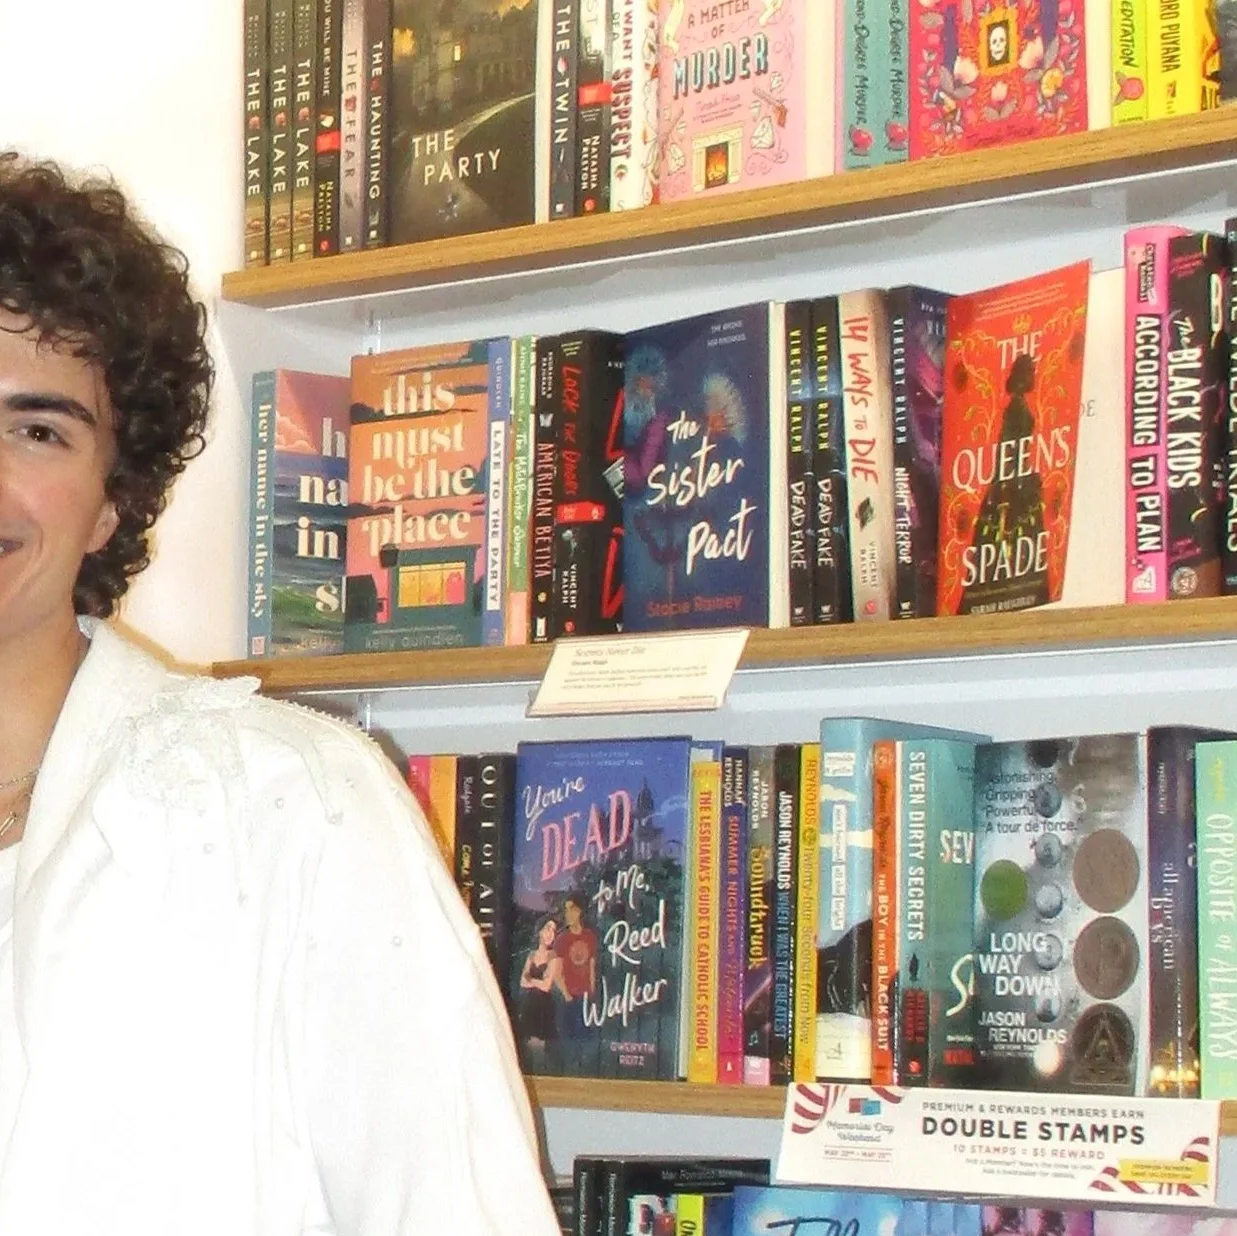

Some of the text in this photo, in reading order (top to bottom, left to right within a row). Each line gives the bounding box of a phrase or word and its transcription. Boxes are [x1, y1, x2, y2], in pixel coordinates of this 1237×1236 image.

[673, 30, 769, 101] MURDER
[246, 68, 260, 196] THE LAKE
[369, 41, 383, 201] THE HAUNTING
[412, 128, 456, 158] THE
[424, 148, 501, 186] PARTY
[996, 330, 1044, 370] THE
[383, 370, 456, 416] this
[1166, 317, 1203, 490] The BLACK KIDS
[372, 421, 465, 469] must
[667, 410, 700, 444] the
[790, 329, 807, 569] VINCENT RALPH DEAD FAKE
[1131, 315, 1161, 552] ACCORDING TO PLAN
[363, 459, 475, 502] be the
[646, 435, 745, 507] Sister
[362, 504, 472, 558] place
[535, 442, 554, 579] AMERICAN BETIYA
[686, 498, 758, 576] Pact
[960, 530, 1051, 588] SPADE
[522, 775, 586, 842] You're
[697, 790, 712, 814] THE
[541, 790, 633, 882] DEAD
[907, 752, 925, 940] SEVEN DIRTY SECRETS
[592, 865, 651, 914] to Me,
[696, 884, 711, 922] GUIDE
[603, 899, 666, 965] Reed
[696, 924, 710, 940] TO
[990, 932, 1047, 953] LONG
[695, 942, 710, 1001] CATHOLIC
[979, 953, 1022, 974] WAY
[994, 976, 1061, 997] DOWN
[582, 976, 668, 1028] Walker
[978, 1011, 1026, 1027] JASON
[694, 1003, 709, 1051] SCHOOL
[989, 1027, 1068, 1044] REYNOLDS
[922, 1102, 974, 1115] PREMIUM
[989, 1104, 1048, 1116] REWARDS
[1051, 1106, 1108, 1118] MEMBERS
[1111, 1109, 1146, 1120] EARN
[922, 1116, 1146, 1146] DOUBLE STAMPS
